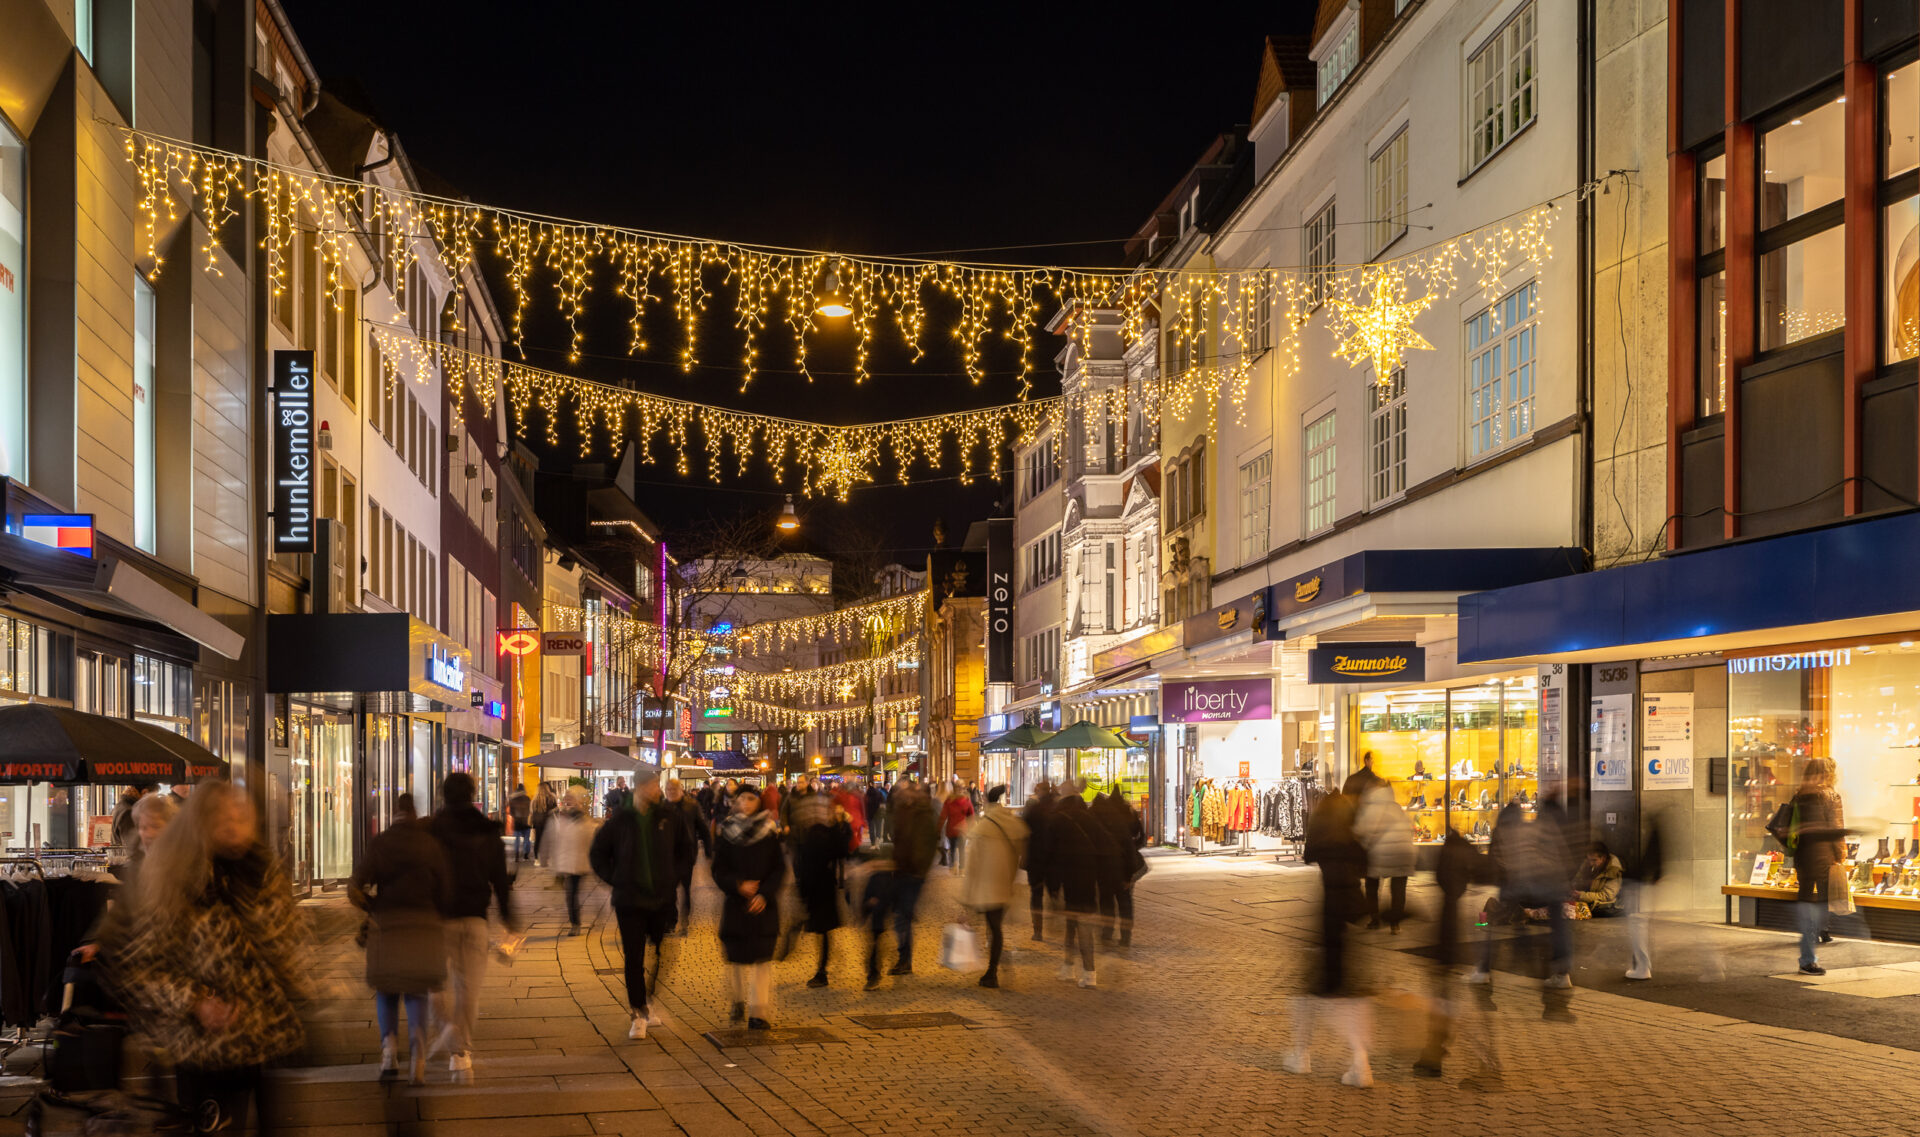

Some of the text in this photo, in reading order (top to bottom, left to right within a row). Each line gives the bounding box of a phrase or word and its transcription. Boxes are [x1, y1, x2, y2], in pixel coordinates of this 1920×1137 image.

[279, 360, 309, 542] hunkemöller
[994, 572, 1008, 633] zero
[546, 639, 583, 650] RENO
[1330, 655, 1407, 677] Zumnorde
[1541, 675, 1551, 687] 37
[1600, 667, 1628, 682] 35/36
[1184, 686, 1248, 713] liberty
[1201, 711, 1231, 719] woman
[95, 763, 173, 775] WOOLWORTH
[1665, 758, 1690, 775] GIVOS
